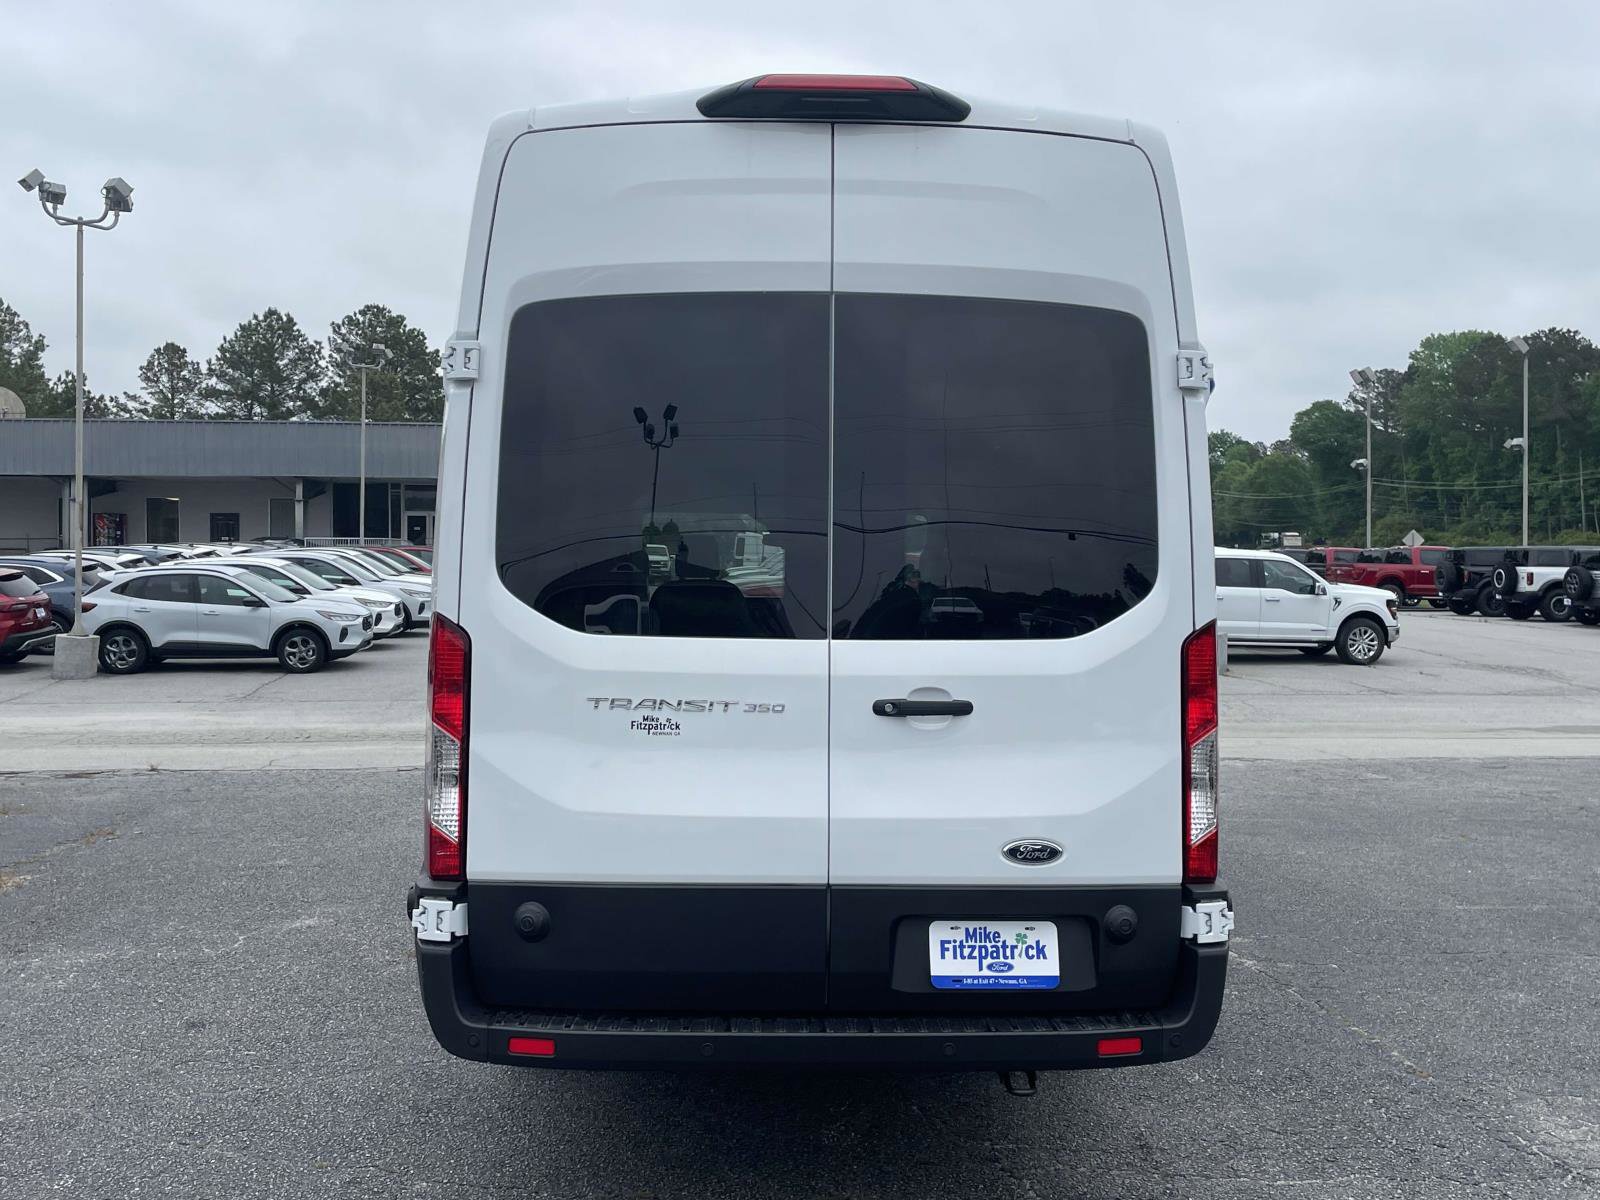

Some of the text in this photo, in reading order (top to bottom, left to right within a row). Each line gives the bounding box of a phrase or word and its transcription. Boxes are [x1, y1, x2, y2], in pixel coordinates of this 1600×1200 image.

[586, 697, 786, 713] TRANSIT 350
[1016, 844, 1051, 859] Ford
[964, 926, 1001, 943] Mike
[940, 933, 1048, 972] Fitzpatrick
[991, 963, 1009, 971] Ford
